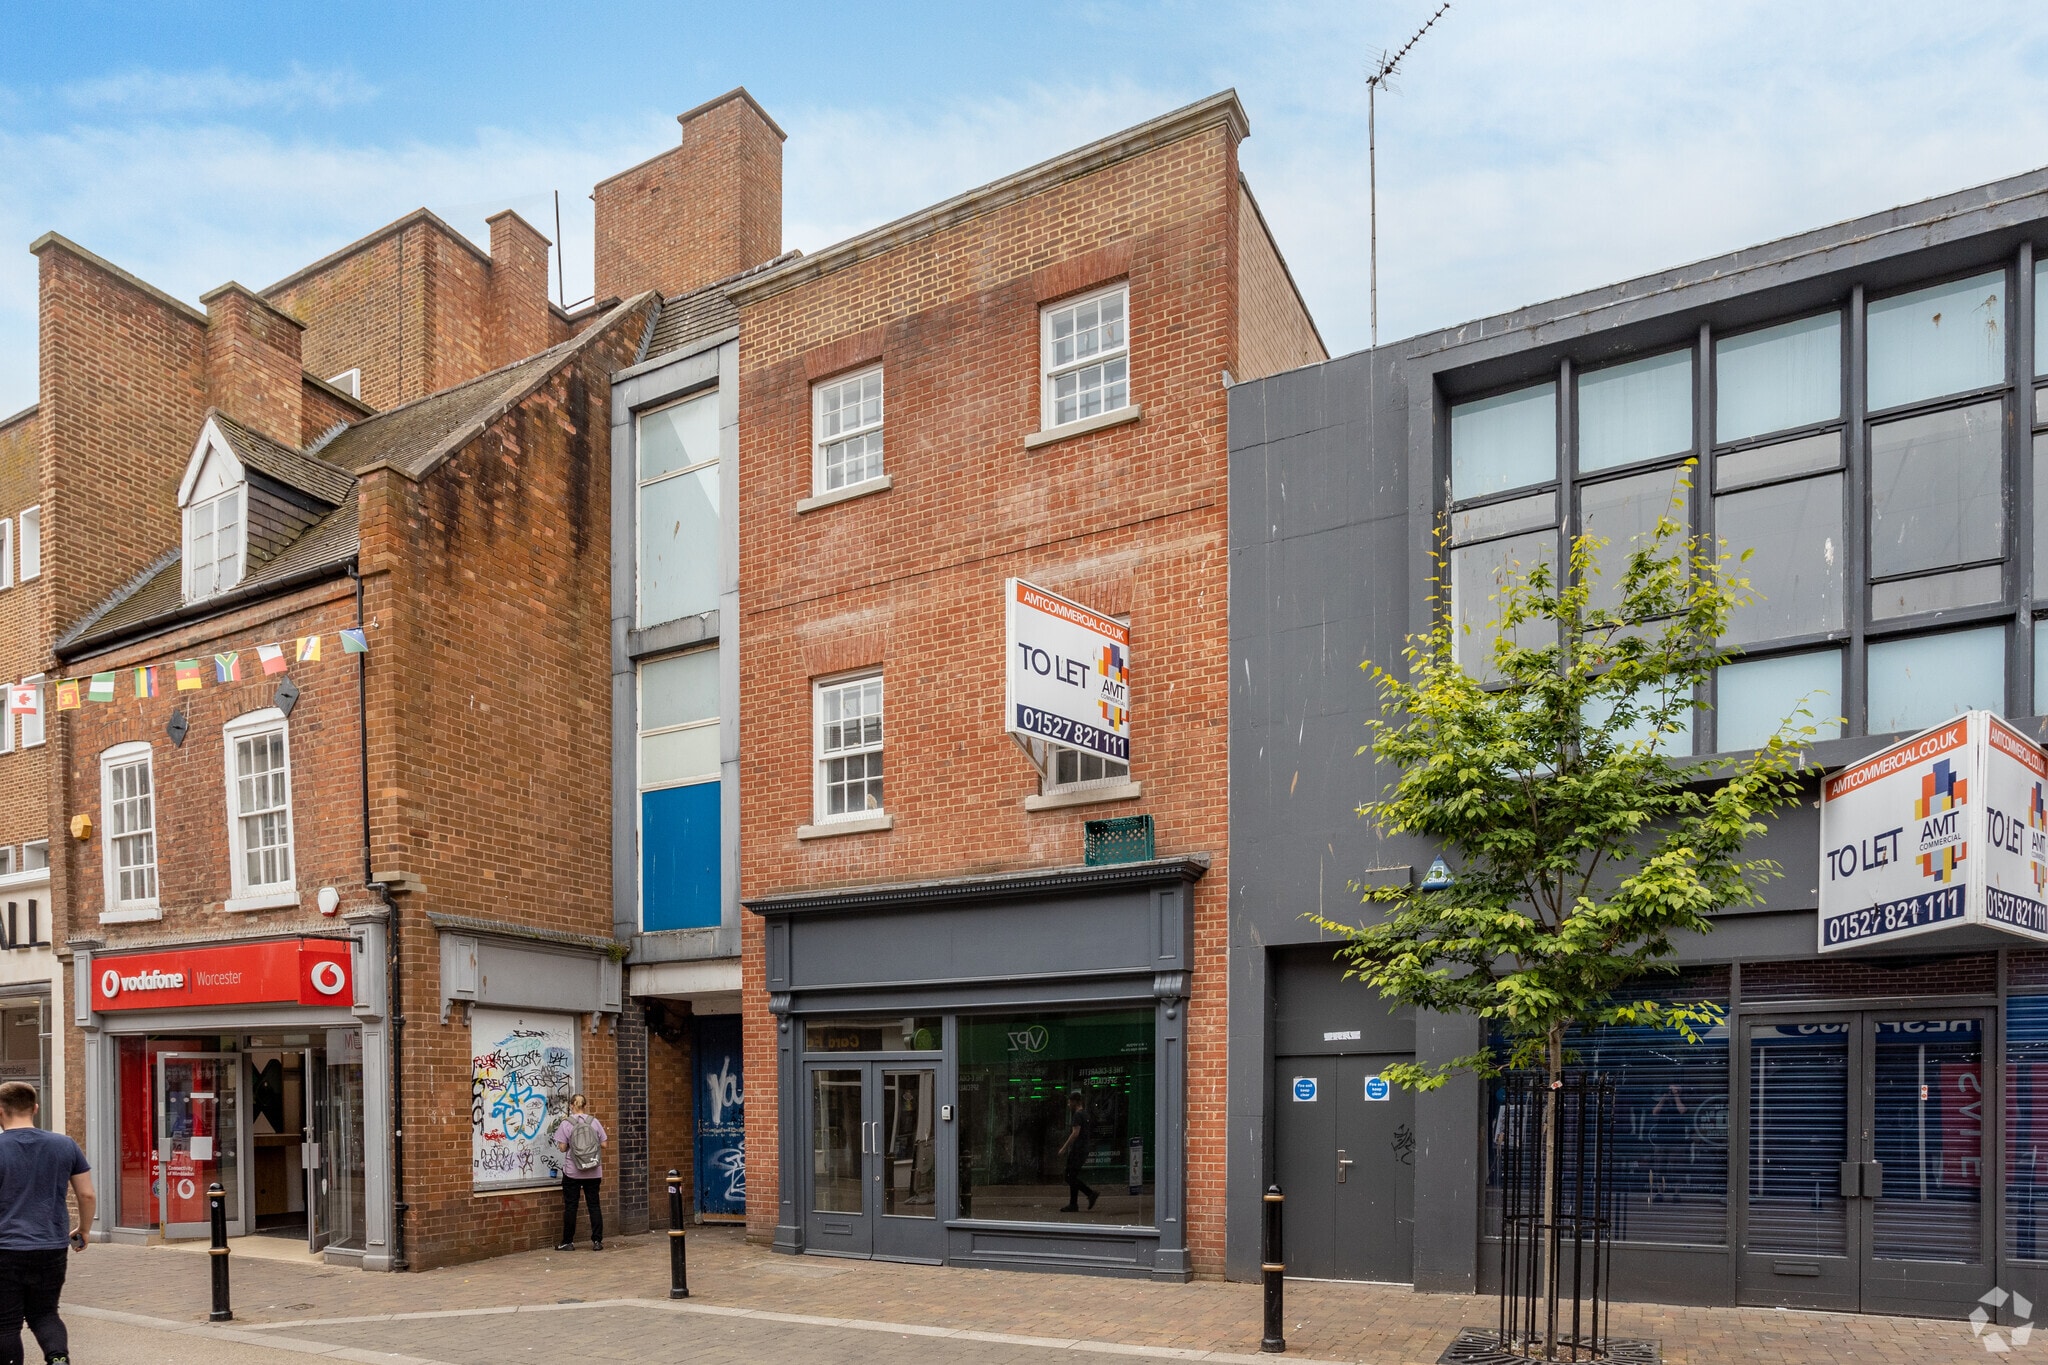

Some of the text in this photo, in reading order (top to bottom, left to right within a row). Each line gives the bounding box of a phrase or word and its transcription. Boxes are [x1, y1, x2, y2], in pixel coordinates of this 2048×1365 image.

[1023, 591, 1124, 641] AMTCOMMERCIAL.CO.UK
[1018, 642, 1090, 689] TO LET
[1100, 693, 1126, 707] COMMERCIAL
[1102, 679, 1125, 700] AMT
[1023, 708, 1125, 757] 01527 821 111
[1990, 727, 2047, 775] AMTCOMMERCIAL.CO.UK
[1831, 728, 1958, 796] AMTCOMMERCIAL.CO.UK
[1919, 833, 1961, 851] COMMERCIAL
[1921, 810, 1959, 842] AMT
[1987, 807, 2024, 856] TO LET
[2032, 832, 2046, 855] AMT
[1827, 827, 1903, 881] TO LET
[1829, 889, 1958, 942] 01527 821 111
[1987, 889, 2047, 931] 01527 821 111
[121, 970, 242, 991] vodafone Worcester
